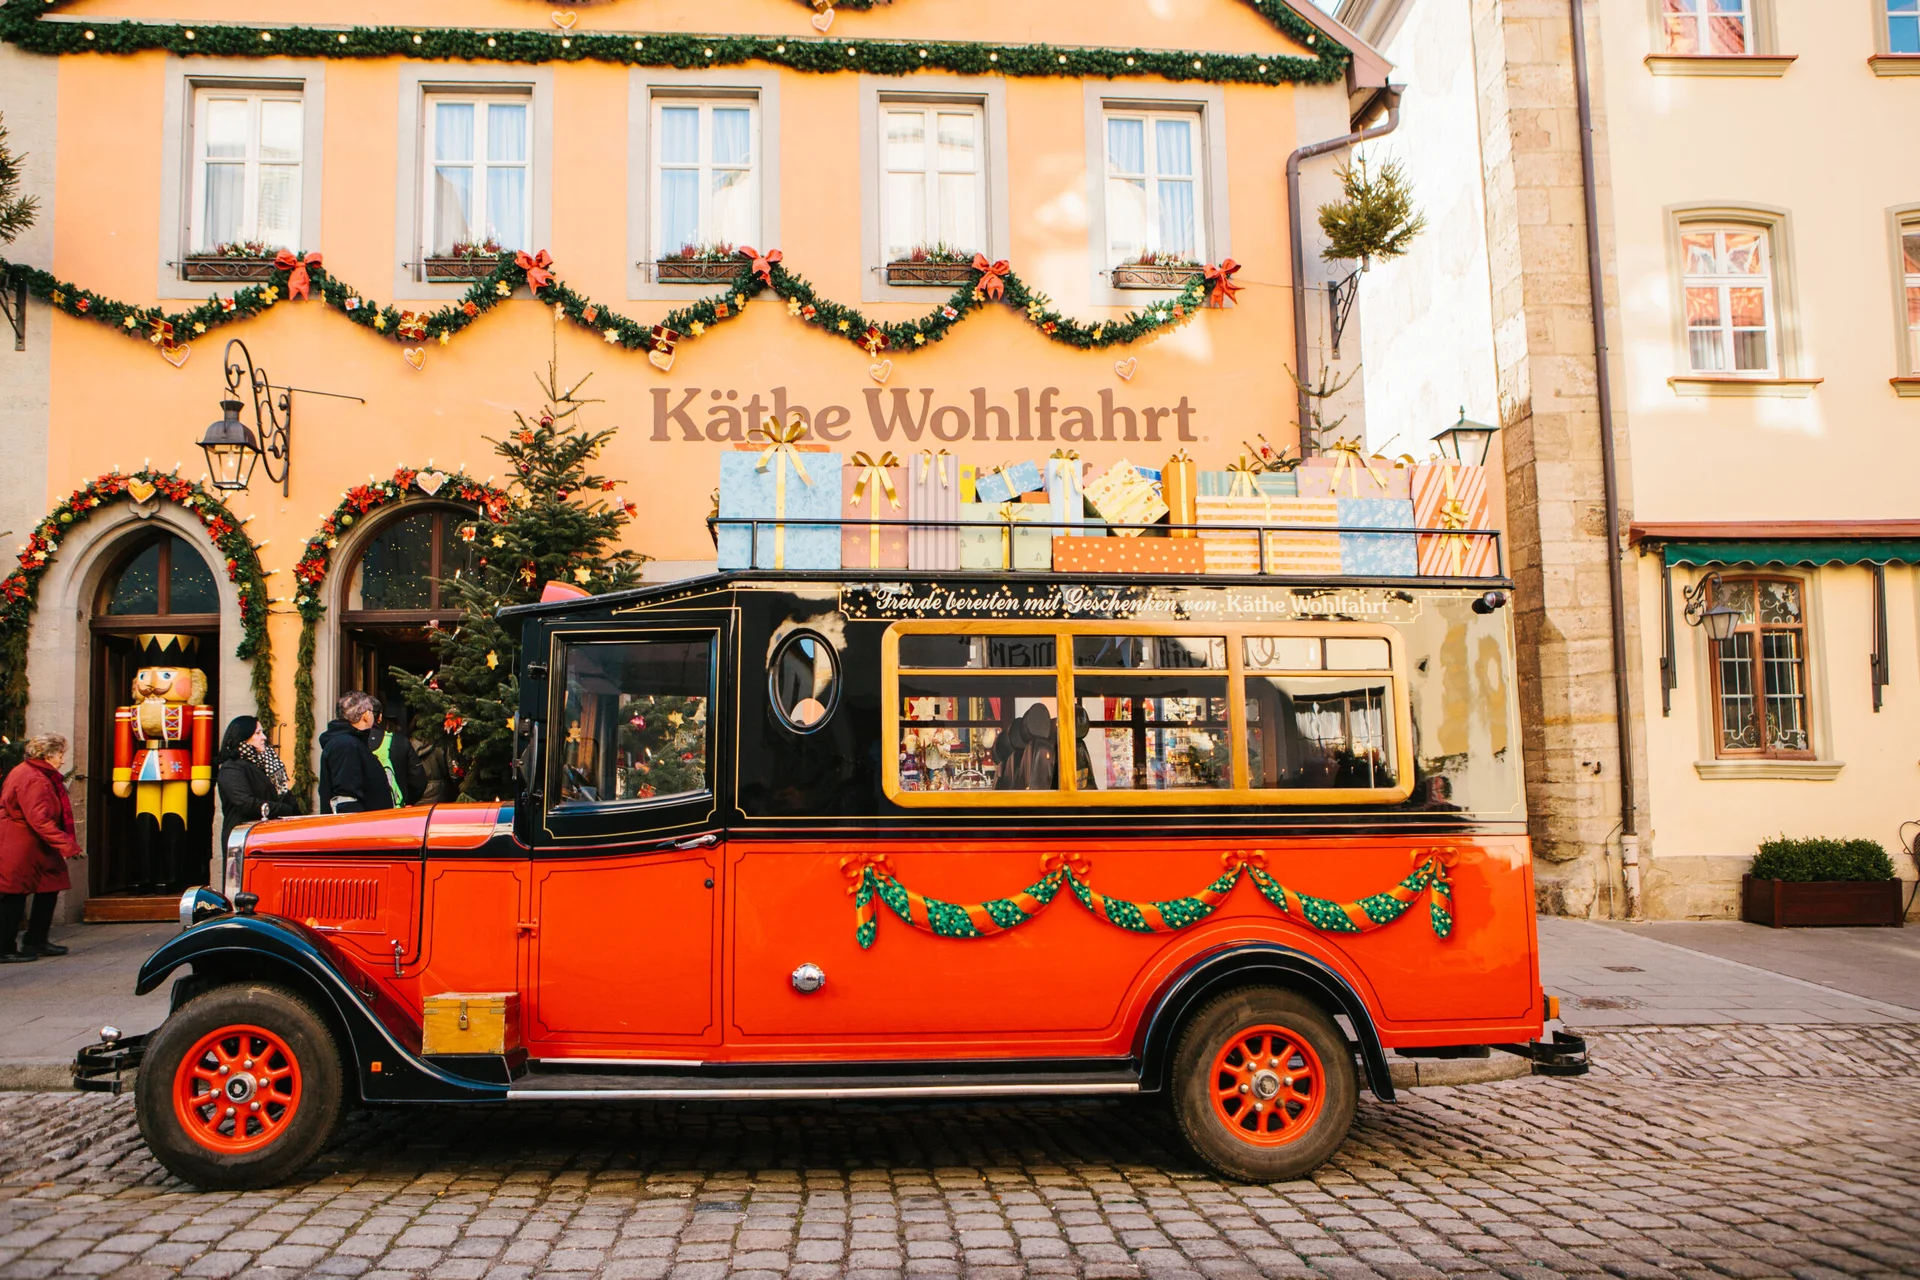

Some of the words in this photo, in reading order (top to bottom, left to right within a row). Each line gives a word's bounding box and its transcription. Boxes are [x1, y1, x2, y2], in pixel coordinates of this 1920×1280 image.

[649, 386, 852, 442] Käthe
[862, 386, 1198, 442] Wohlfahrt
[876, 587, 942, 610] Freude
[945, 590, 1019, 611] bereiten
[1023, 593, 1061, 610] mit
[1065, 587, 1178, 613] Geschenken
[1181, 597, 1218, 612] von
[1226, 594, 1286, 613] Käthe
[1290, 595, 1390, 614] Wohlfahrt
